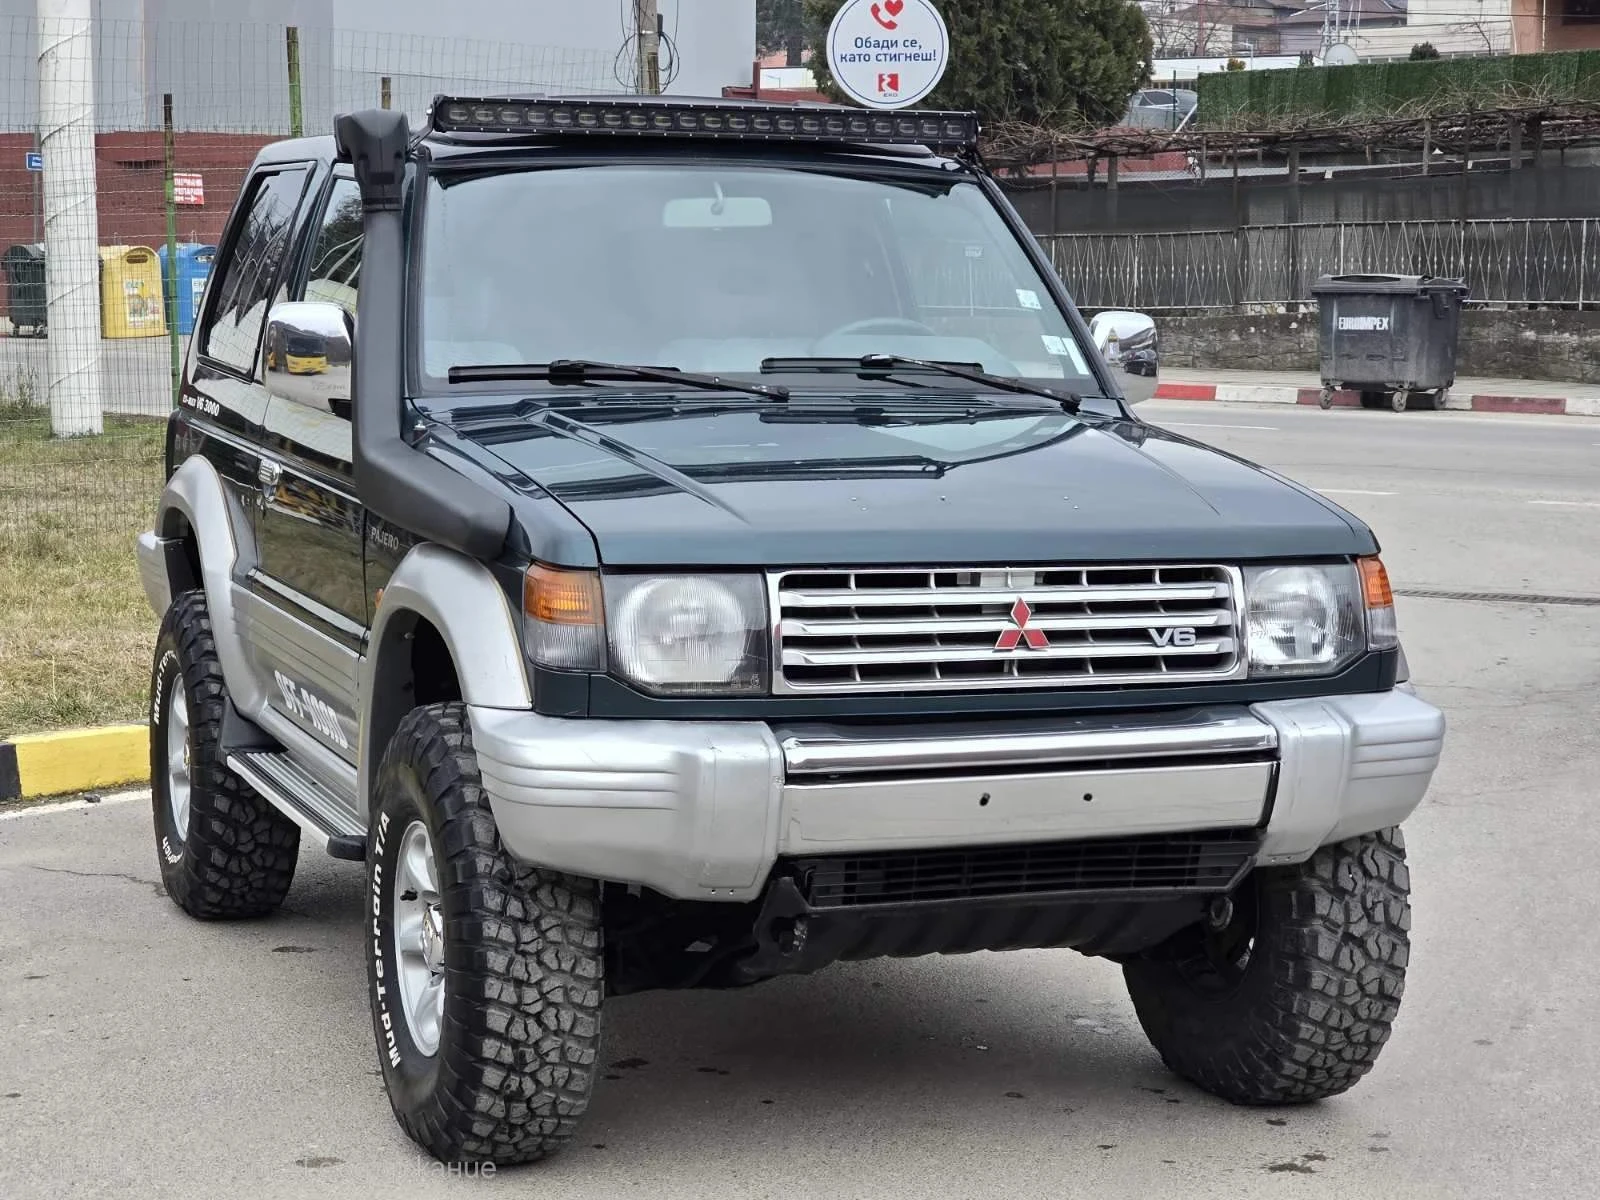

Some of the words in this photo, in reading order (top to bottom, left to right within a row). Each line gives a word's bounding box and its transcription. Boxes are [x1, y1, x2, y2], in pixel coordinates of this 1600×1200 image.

[854, 36, 898, 50] Обади
[902, 39, 922, 50] се,
[840, 52, 871, 63] като
[875, 49, 936, 62] стигнеш!
[203, 399, 220, 417] 3000
[370, 526, 399, 550] PAJERO
[1147, 627, 1197, 647] V6
[374, 811, 390, 857] T/A
[373, 863, 401, 1068] Mud-Terrain
